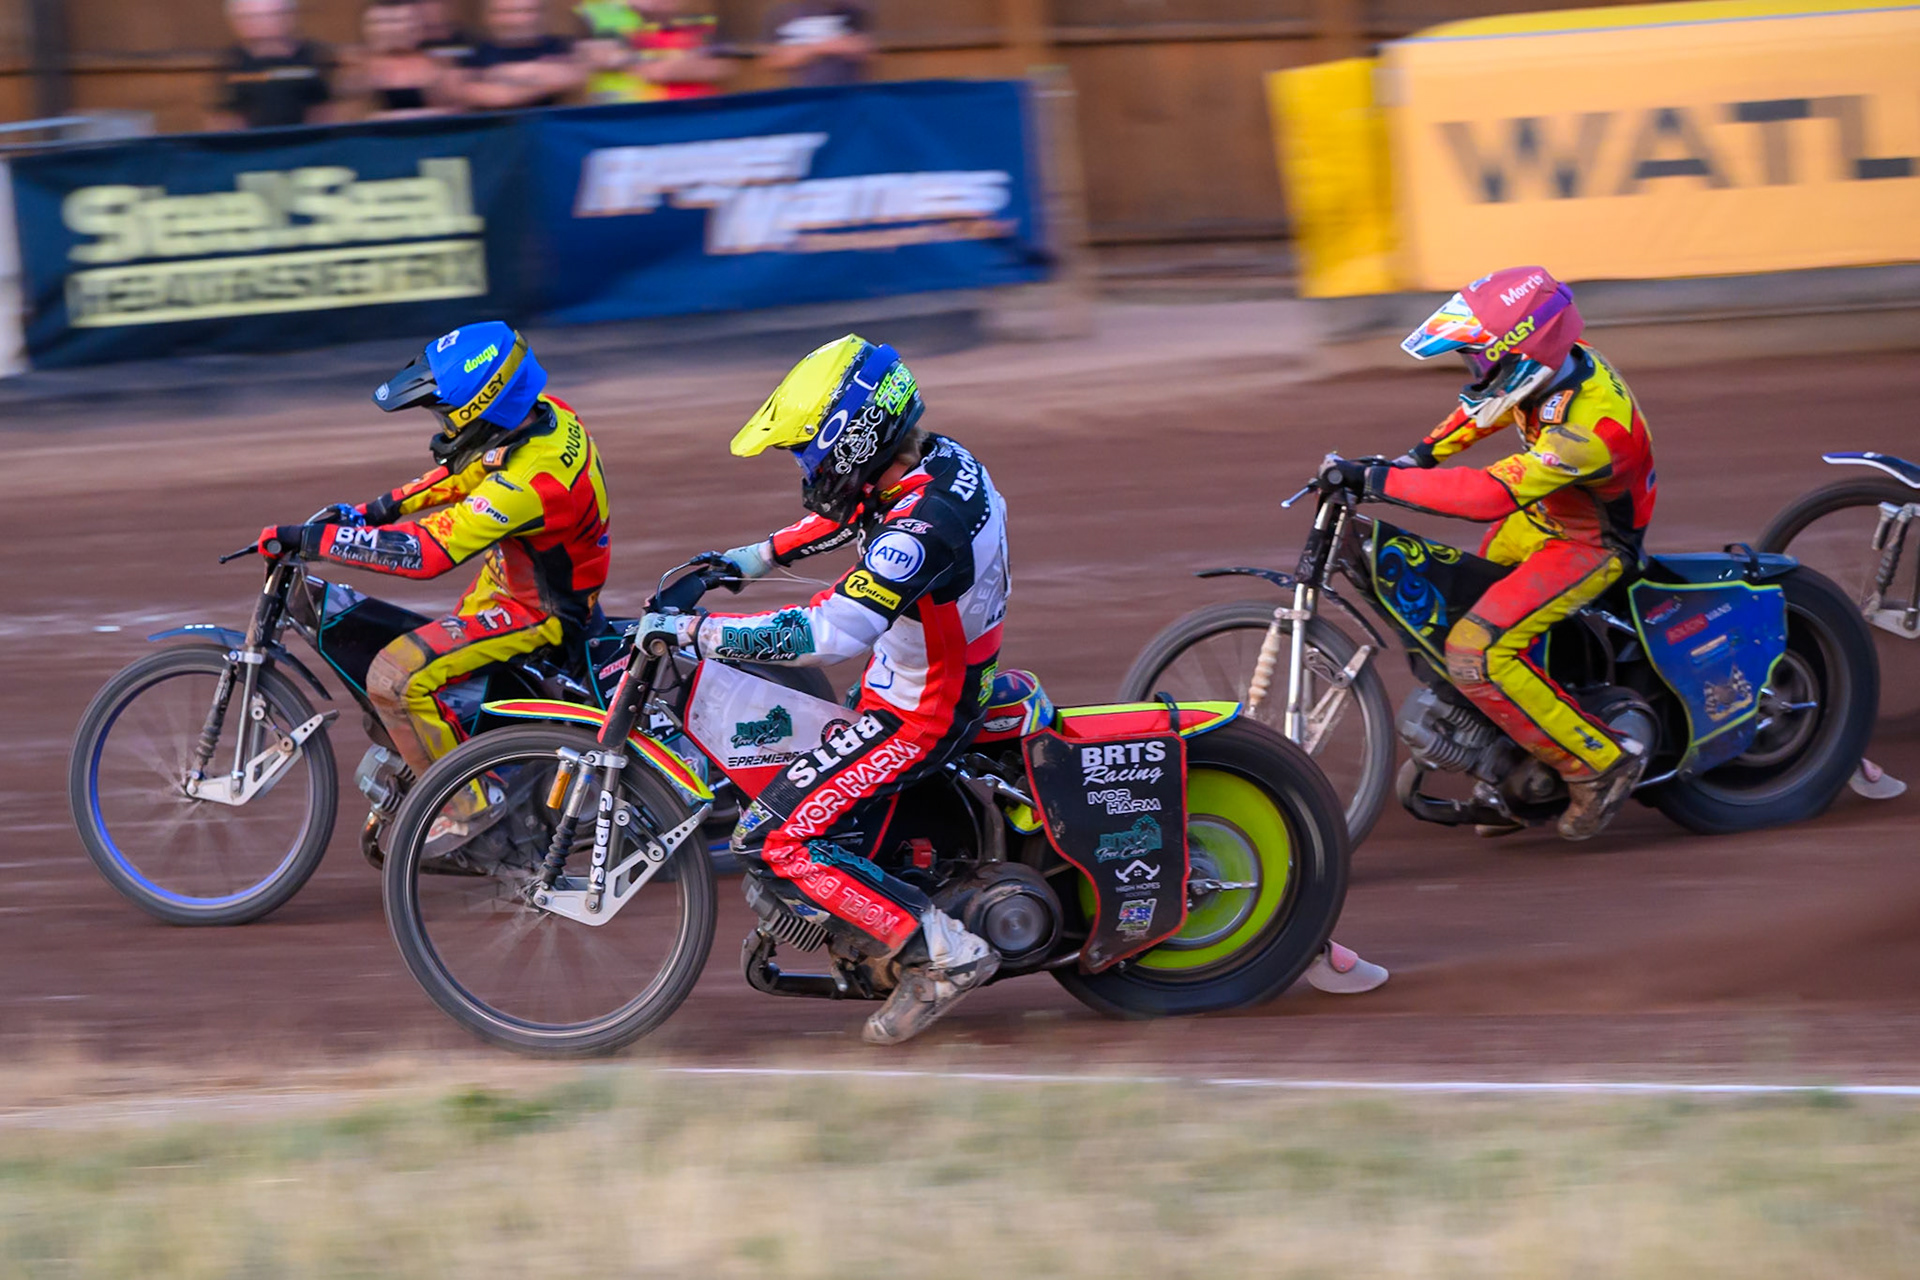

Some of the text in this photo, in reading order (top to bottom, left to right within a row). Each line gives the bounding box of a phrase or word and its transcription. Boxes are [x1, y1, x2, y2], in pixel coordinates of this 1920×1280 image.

[1500, 273, 1544, 307] Morris
[1485, 315, 1536, 362] OAKLEY
[463, 343, 499, 374] dougy
[459, 372, 505, 421] OAKLEY
[559, 415, 582, 468] DOUGL
[485, 507, 509, 524] PRO
[335, 526, 380, 550] BM
[874, 545, 914, 569] ATPI
[848, 575, 898, 608] Rentruck
[722, 627, 815, 653] BOSTON
[786, 712, 884, 789] BRTS
[1081, 741, 1165, 768] BRTS
[1083, 764, 1164, 786] Racing
[1087, 788, 1131, 804] IVOR
[1106, 798, 1162, 815] HARM
[840, 886, 899, 935] NOEL
